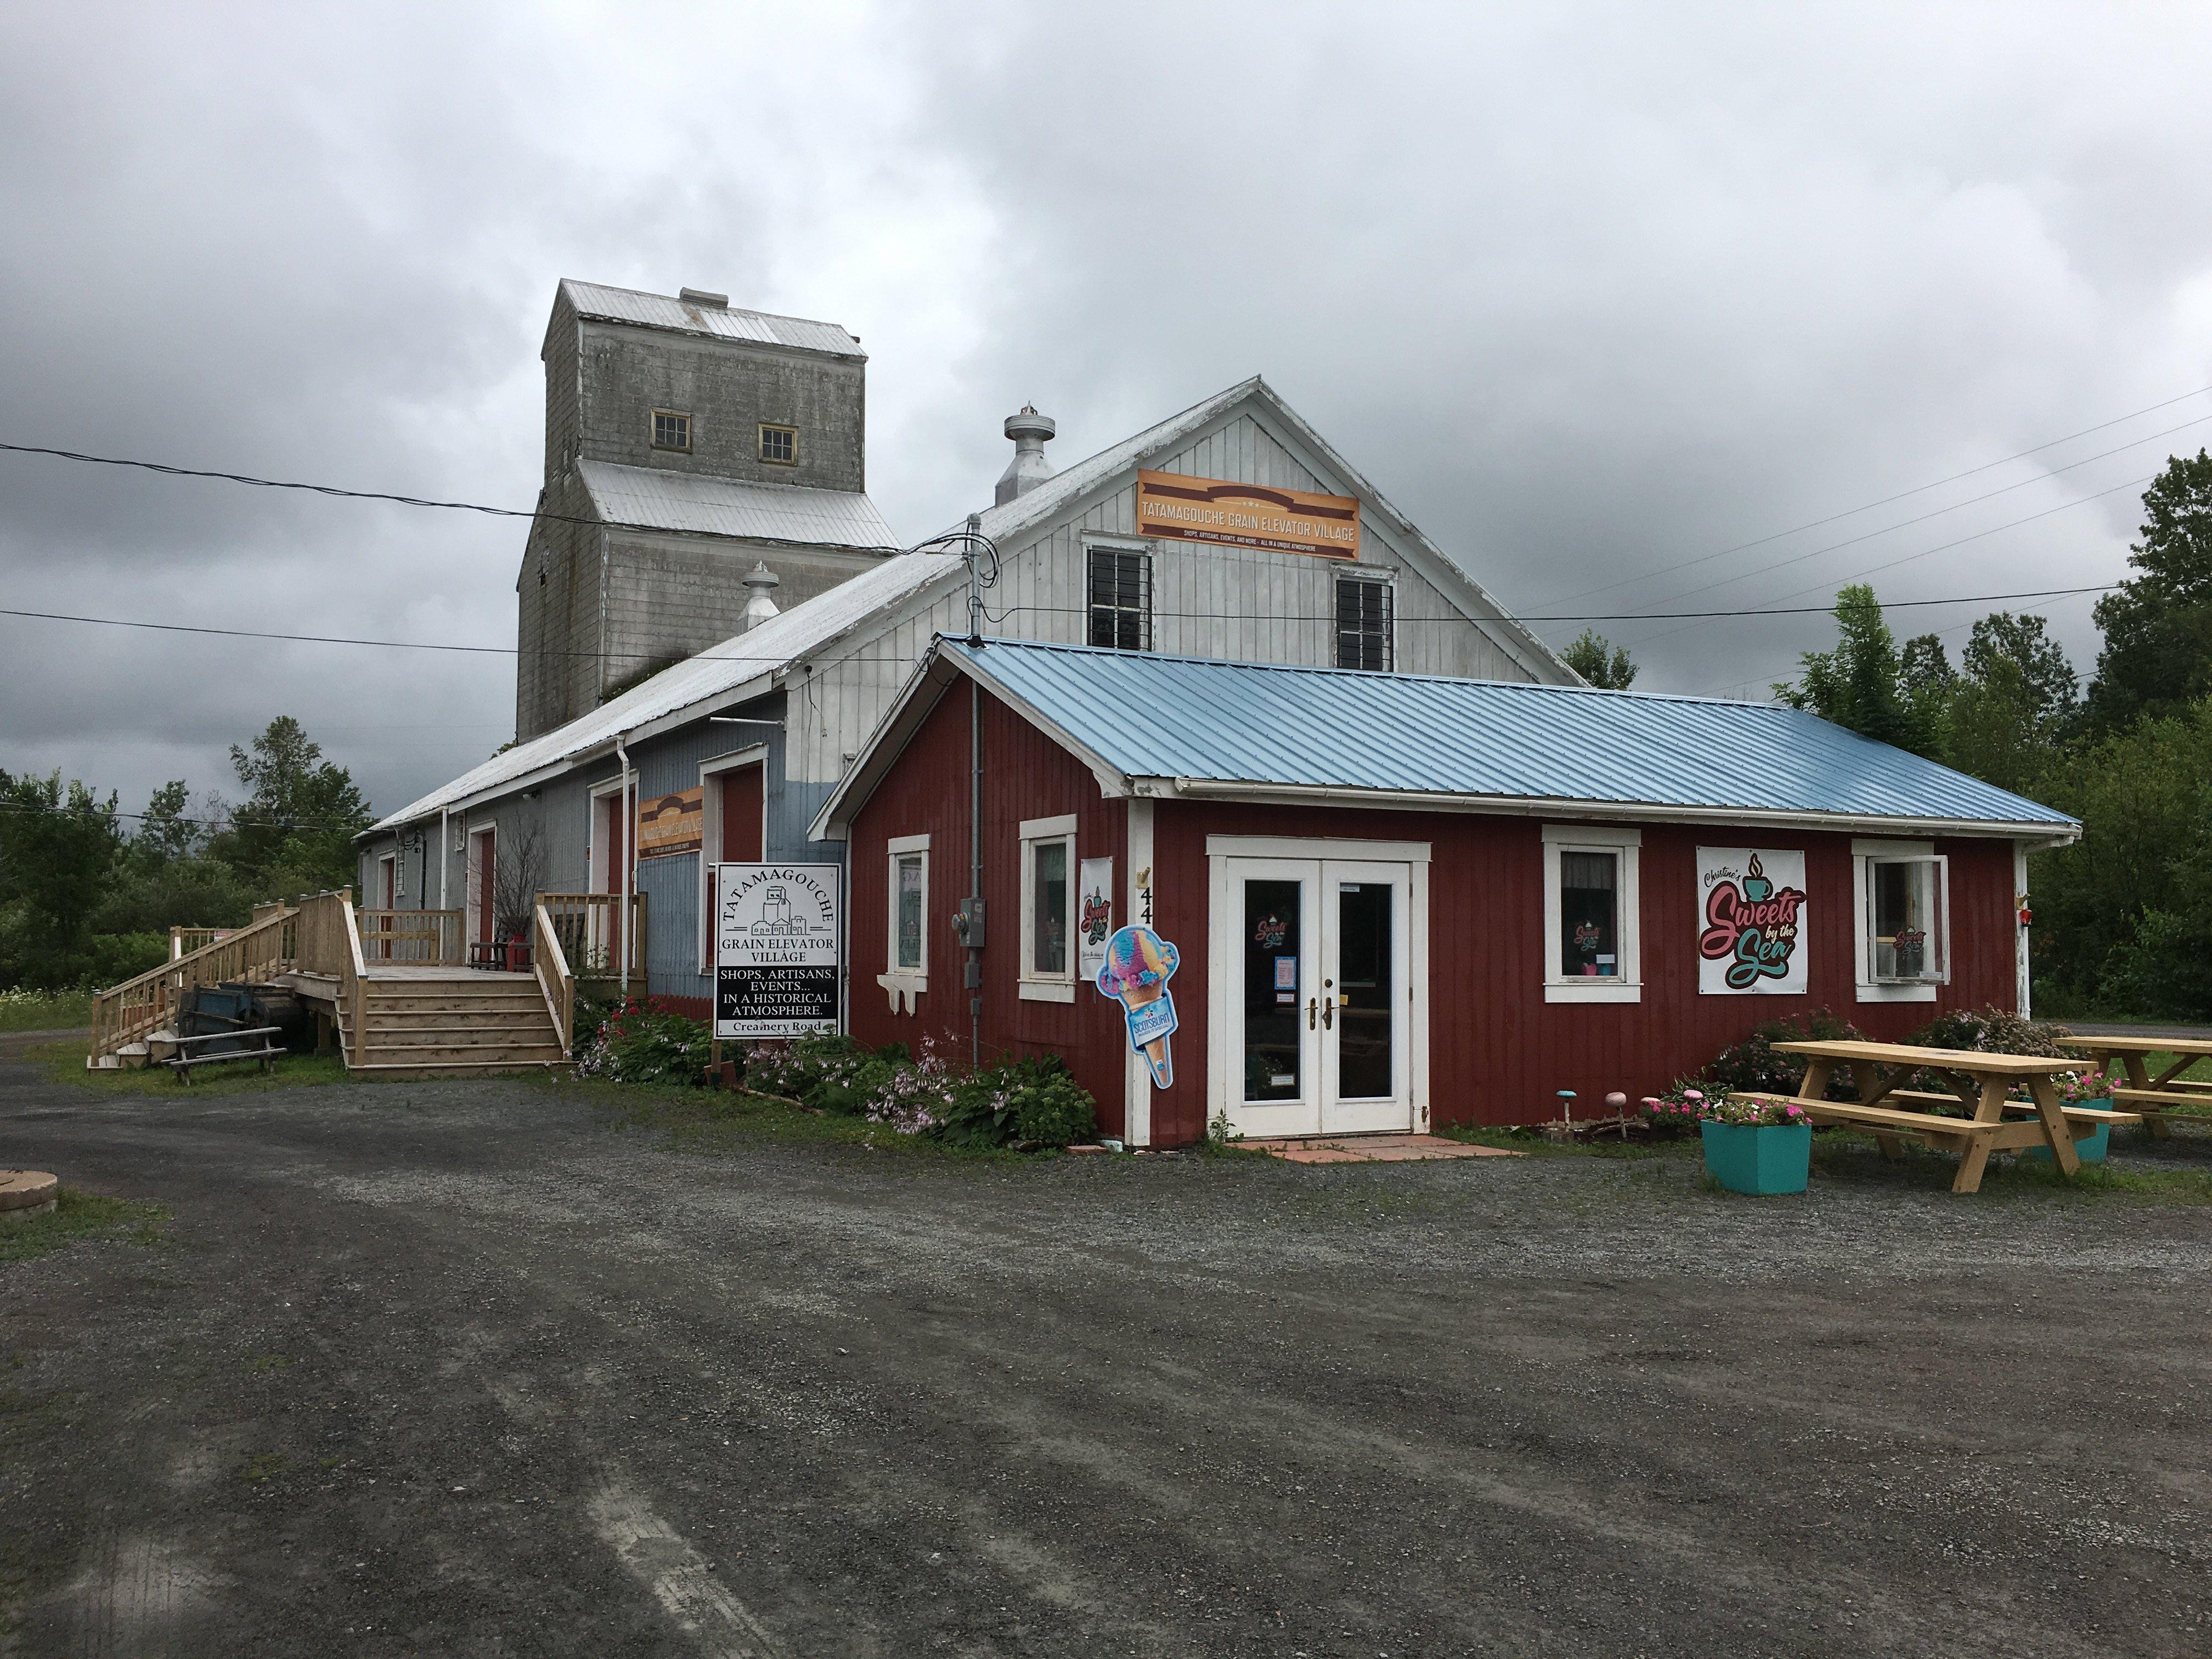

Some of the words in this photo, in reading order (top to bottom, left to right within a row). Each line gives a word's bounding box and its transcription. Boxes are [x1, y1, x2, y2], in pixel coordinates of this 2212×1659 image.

[1142, 501, 1225, 526] TATAMAGOUCHE
[1228, 512, 1258, 529] GRAIN
[1262, 517, 1311, 537] ELEVATOR
[1314, 524, 1355, 541] VILLAGE
[1704, 866, 1741, 888] Christine's
[723, 868, 833, 922] TATAMAGOUCHE
[1701, 885, 1802, 955] Sweets
[1765, 925, 1778, 944] by
[1780, 925, 1795, 937] the
[722, 939, 765, 949] GRAIN
[769, 939, 834, 949] ELEVATOR
[752, 952, 806, 962] VILLAGE
[1729, 928, 1791, 985] Sea
[720, 969, 765, 981] SHOPS,
[768, 969, 835, 980] ARTISANS,
[751, 981, 810, 991] EVENTS...
[724, 994, 737, 1003] IN
[741, 994, 751, 1003] A
[754, 994, 831, 1003] HISTORICAL
[732, 1006, 822, 1016] ATMOSPHERE.
[792, 1021, 821, 1031] Road
[1133, 1013, 1170, 1034] SCOTSBURN
